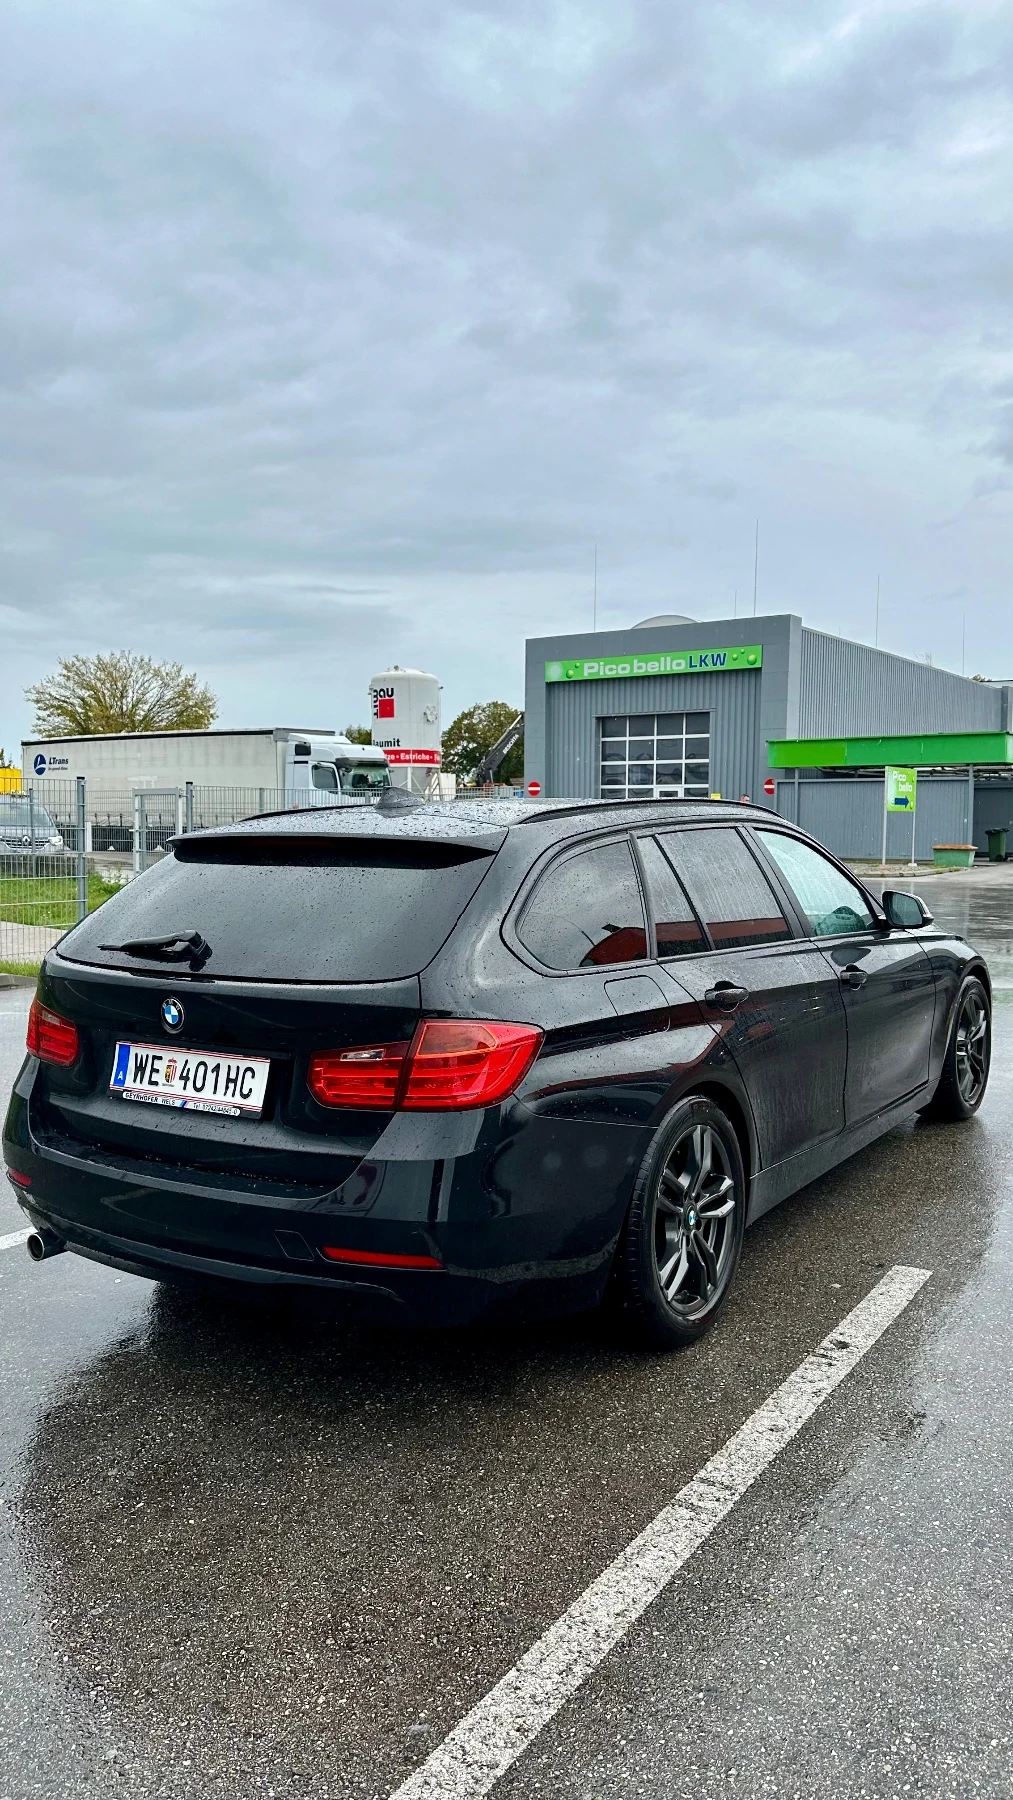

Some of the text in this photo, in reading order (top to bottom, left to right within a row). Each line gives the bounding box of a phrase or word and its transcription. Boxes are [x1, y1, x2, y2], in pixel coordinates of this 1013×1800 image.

[583, 652, 727, 677] Pico bello LKW
[892, 770, 906, 782] Pico
[898, 782, 912, 792] bello
[117, 1071, 124, 1080] A
[132, 1052, 257, 1100] WE 401HC
